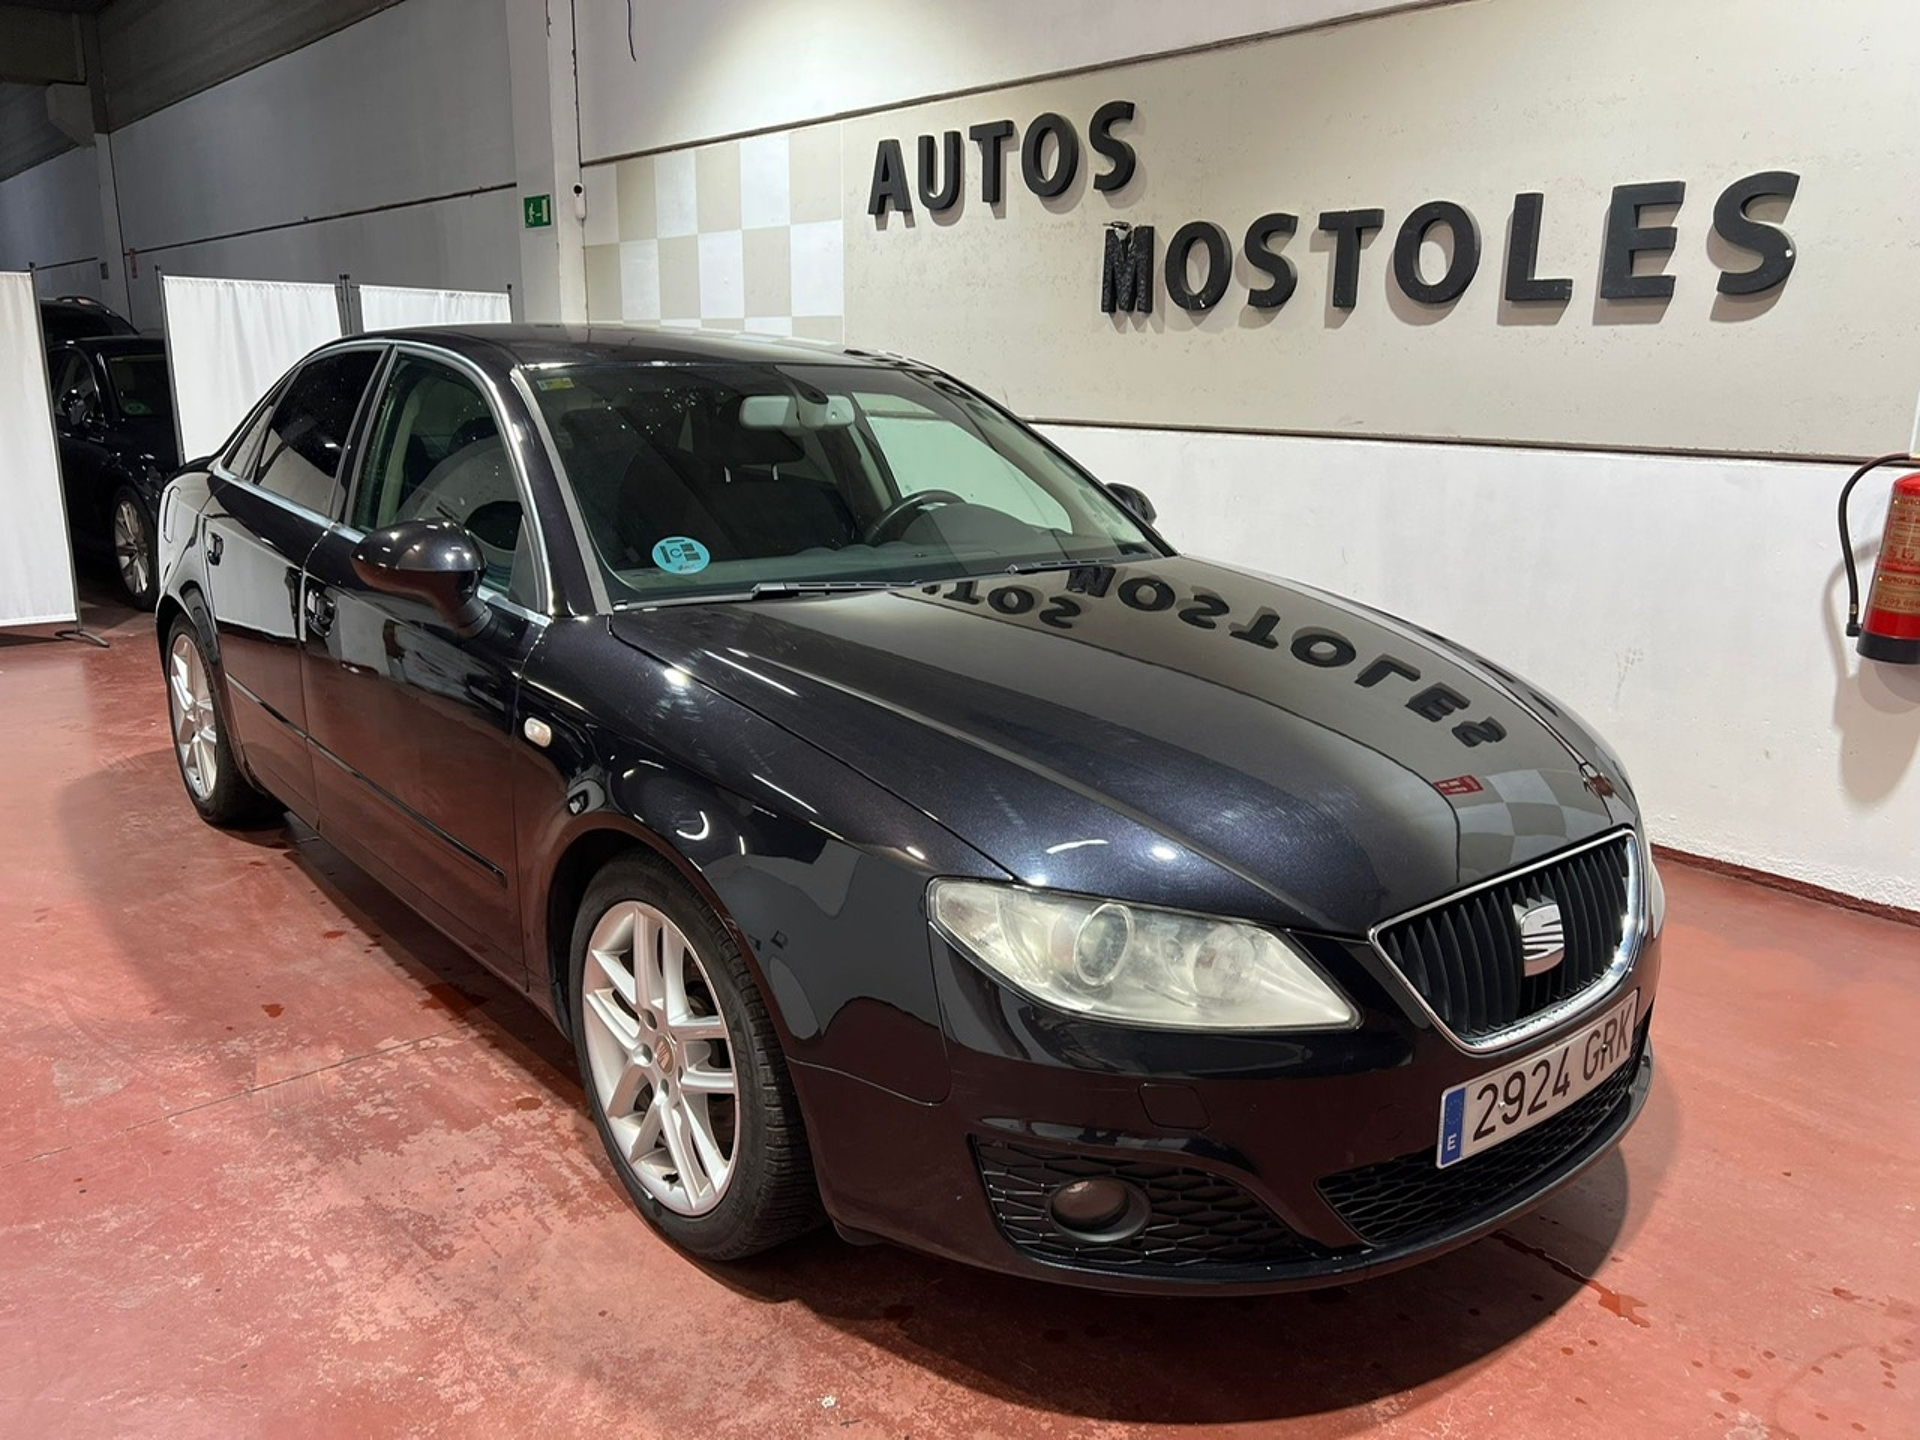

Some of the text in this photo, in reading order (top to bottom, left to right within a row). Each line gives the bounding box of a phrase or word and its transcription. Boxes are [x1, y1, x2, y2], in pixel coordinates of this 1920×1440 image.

[867, 101, 1137, 216] AUTOS
[1101, 171, 1800, 314] MOSTOLES
[1472, 1003, 1633, 1142] 2924 GRK
[1446, 1133, 1457, 1151] E
